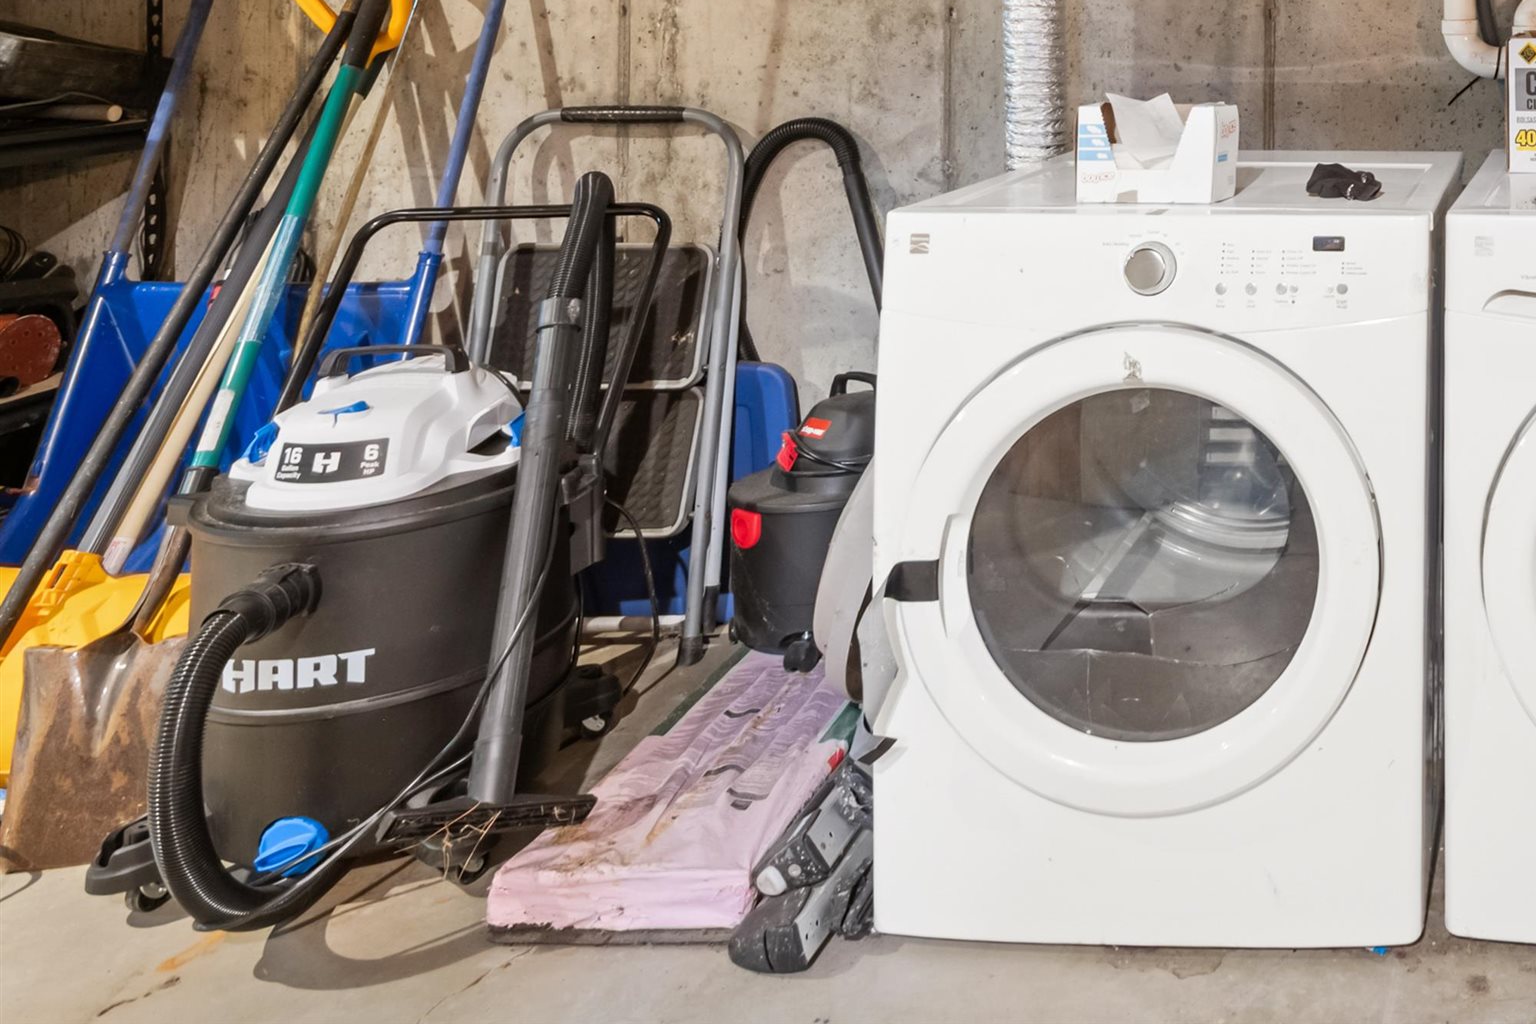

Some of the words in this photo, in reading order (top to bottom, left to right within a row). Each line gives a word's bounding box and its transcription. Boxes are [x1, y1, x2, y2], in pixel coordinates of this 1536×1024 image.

[1516, 116, 1536, 124] BOLSAS
[284, 447, 303, 464] 16
[363, 444, 379, 461] 6
[311, 451, 342, 474] H
[222, 648, 376, 694] HART
